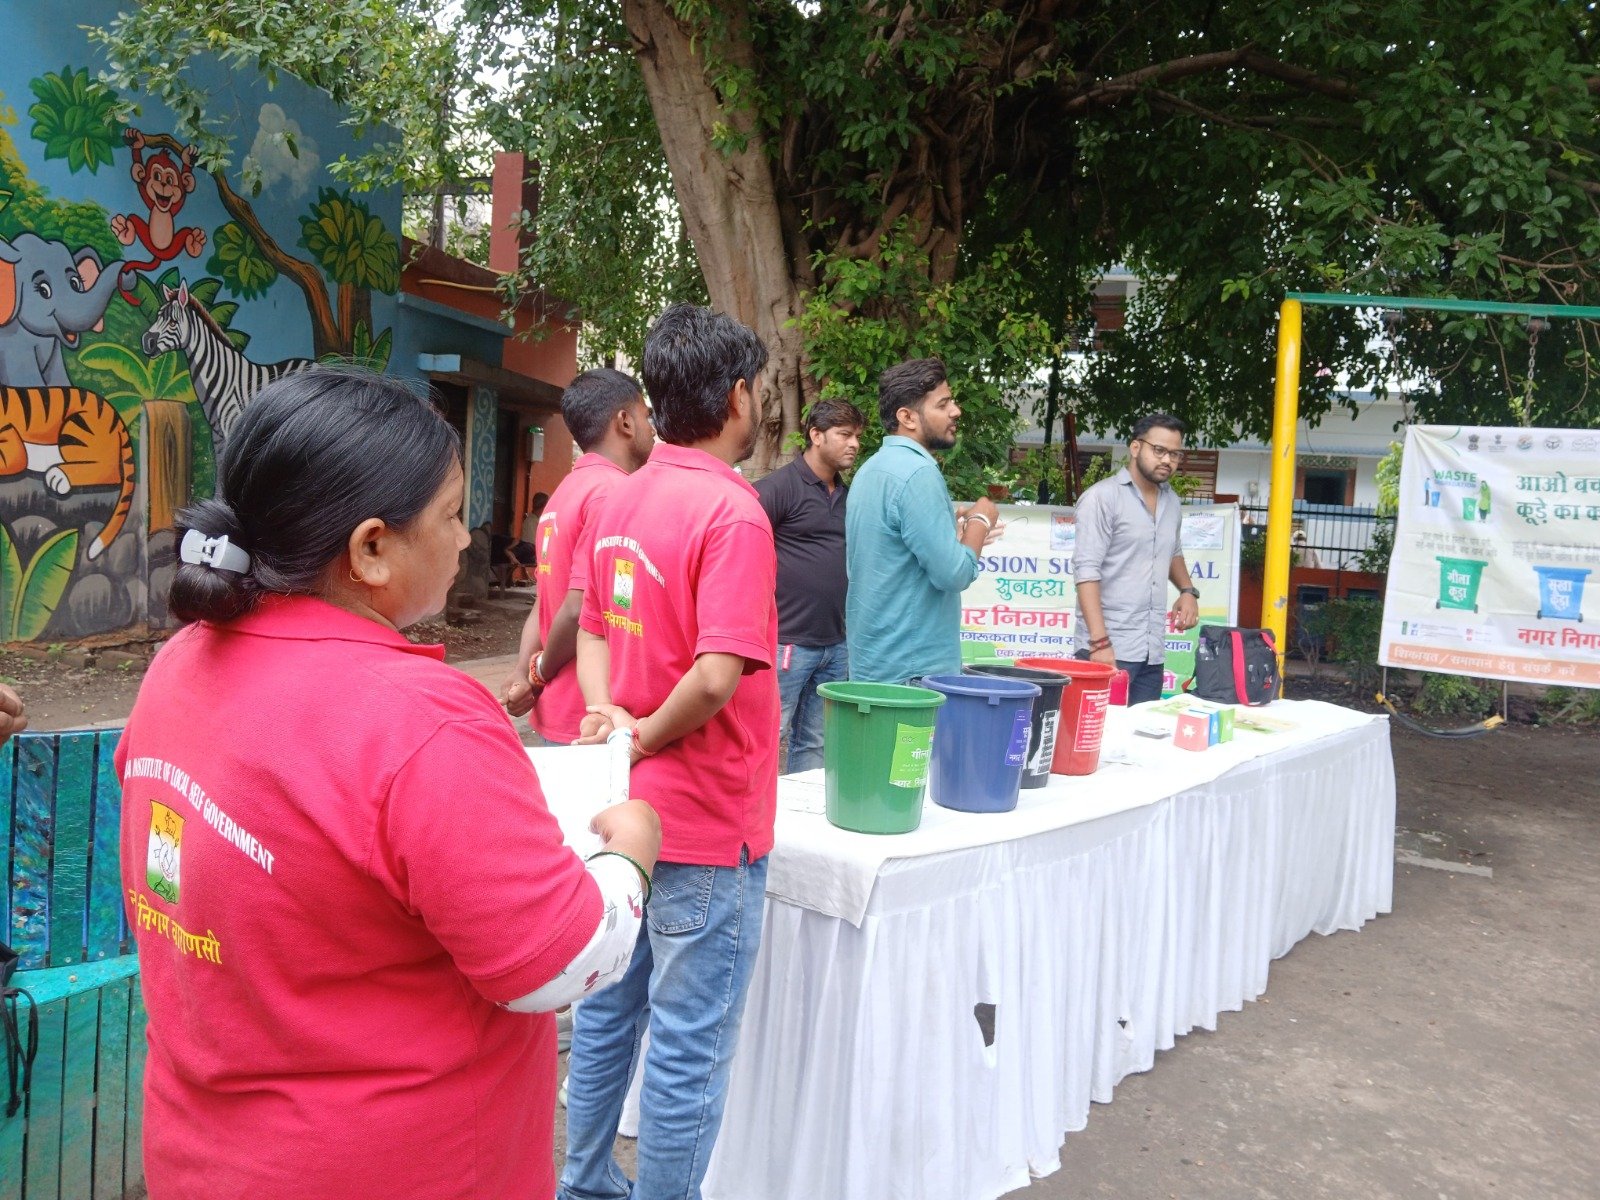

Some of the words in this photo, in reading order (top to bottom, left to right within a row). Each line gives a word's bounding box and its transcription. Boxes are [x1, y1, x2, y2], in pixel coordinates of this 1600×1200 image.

[1433, 469, 1478, 483] WASTE
[1516, 471, 1568, 493] आओ
[1553, 505, 1581, 520] का
[977, 556, 1037, 573] SSION
[1190, 560, 1220, 579] AL
[1447, 569, 1470, 585] गीला
[996, 578, 1065, 600] सुनहरा
[992, 604, 1070, 628] निगम
[1040, 636, 1063, 645] जन
[1518, 628, 1557, 646] नगर
[1562, 627, 1600, 649] निग
[170, 765, 190, 798] LOCAL
[203, 798, 275, 875] GOVERNMENT
[137, 893, 170, 939] निगम
